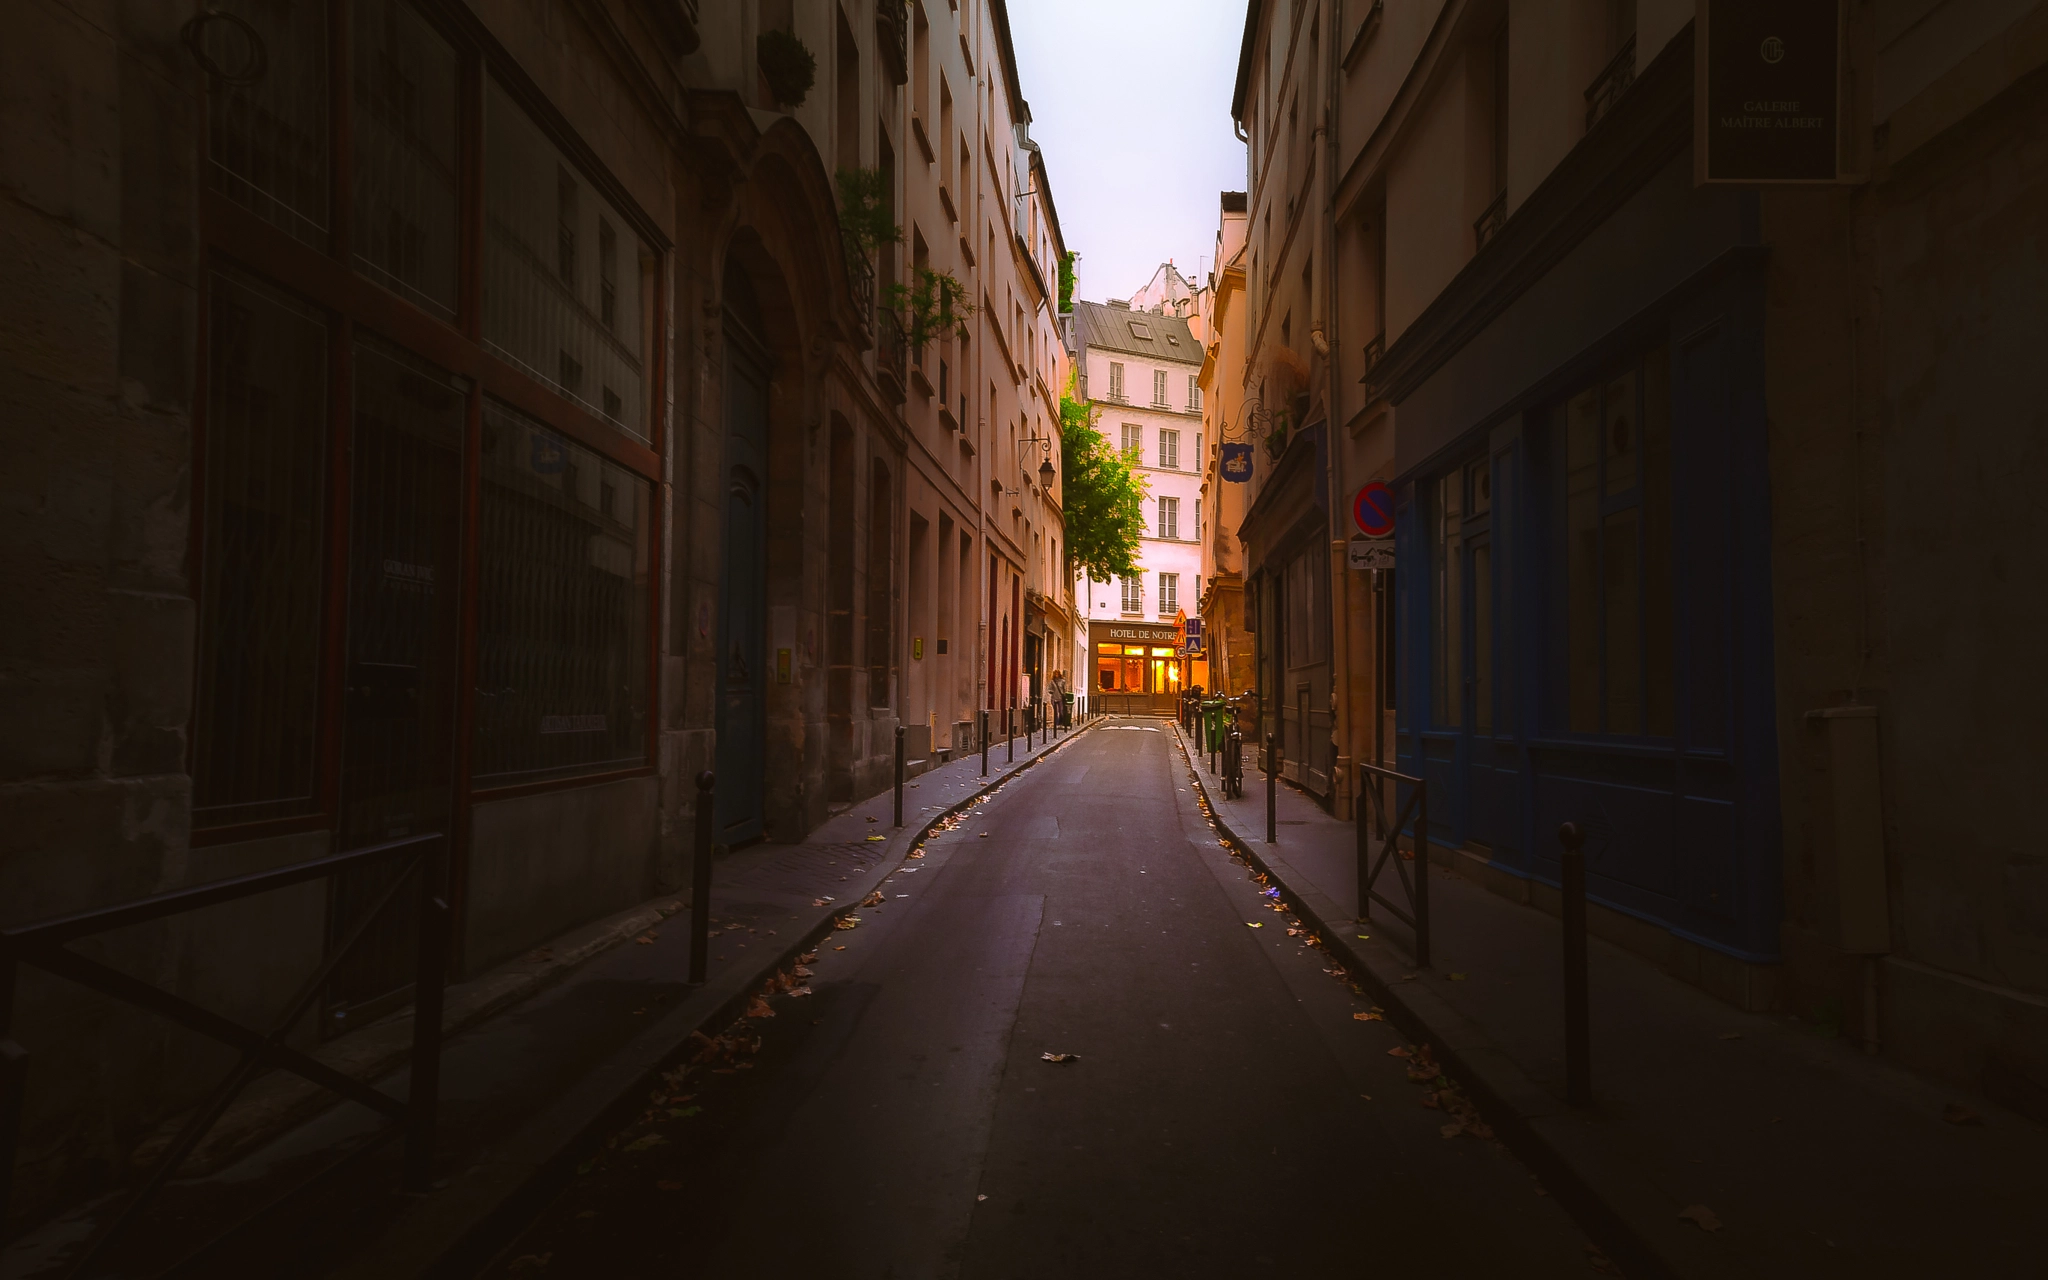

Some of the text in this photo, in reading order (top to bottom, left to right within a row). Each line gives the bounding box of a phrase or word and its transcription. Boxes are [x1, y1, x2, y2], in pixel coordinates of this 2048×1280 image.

[1743, 101, 1801, 112] GALERIE
[1720, 115, 1825, 128] MAÎTRE ALBERT
[1110, 629, 1178, 640] HOTEL DE NOTRE
